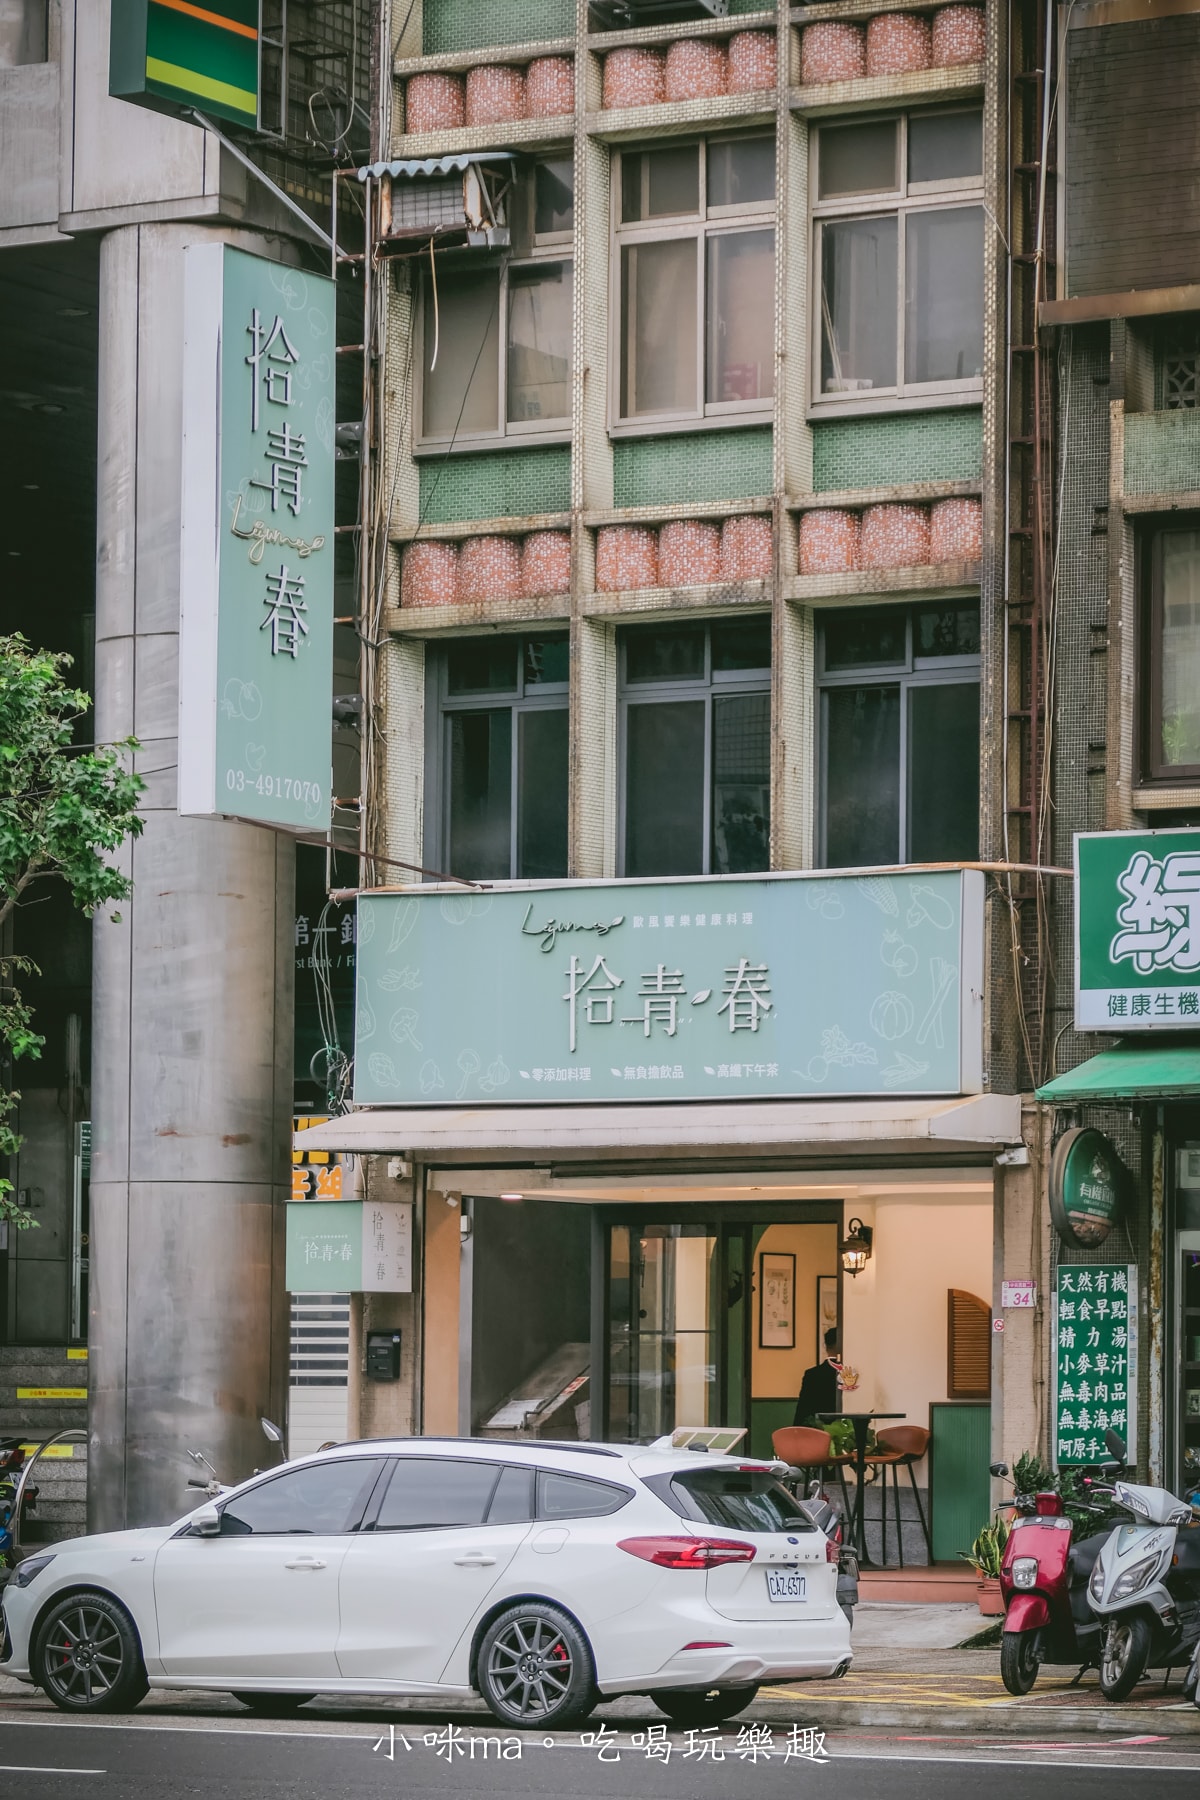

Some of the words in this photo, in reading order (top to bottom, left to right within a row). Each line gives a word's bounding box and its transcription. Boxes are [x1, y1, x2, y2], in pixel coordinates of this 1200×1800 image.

[246, 308, 310, 660] 拾青春
[226, 769, 320, 803] 03-4917070
[562, 954, 773, 1053] 拾青春
[1107, 991, 1200, 1017] 健康生機
[531, 1067, 591, 1082] 零添加料理
[623, 1065, 684, 1080] 無負擔飲品
[717, 1063, 779, 1078] 高纖下午茶
[304, 1241, 353, 1265] 拾青春
[1060, 1270, 1128, 1293] 天然有機
[1013, 1292, 1030, 1305] 34
[1059, 1298, 1128, 1321] 輕食早點
[1059, 1353, 1127, 1376] 小麥草汁
[1059, 1380, 1127, 1404] 無毒肉品
[1058, 1407, 1127, 1431] 無毒海鮮
